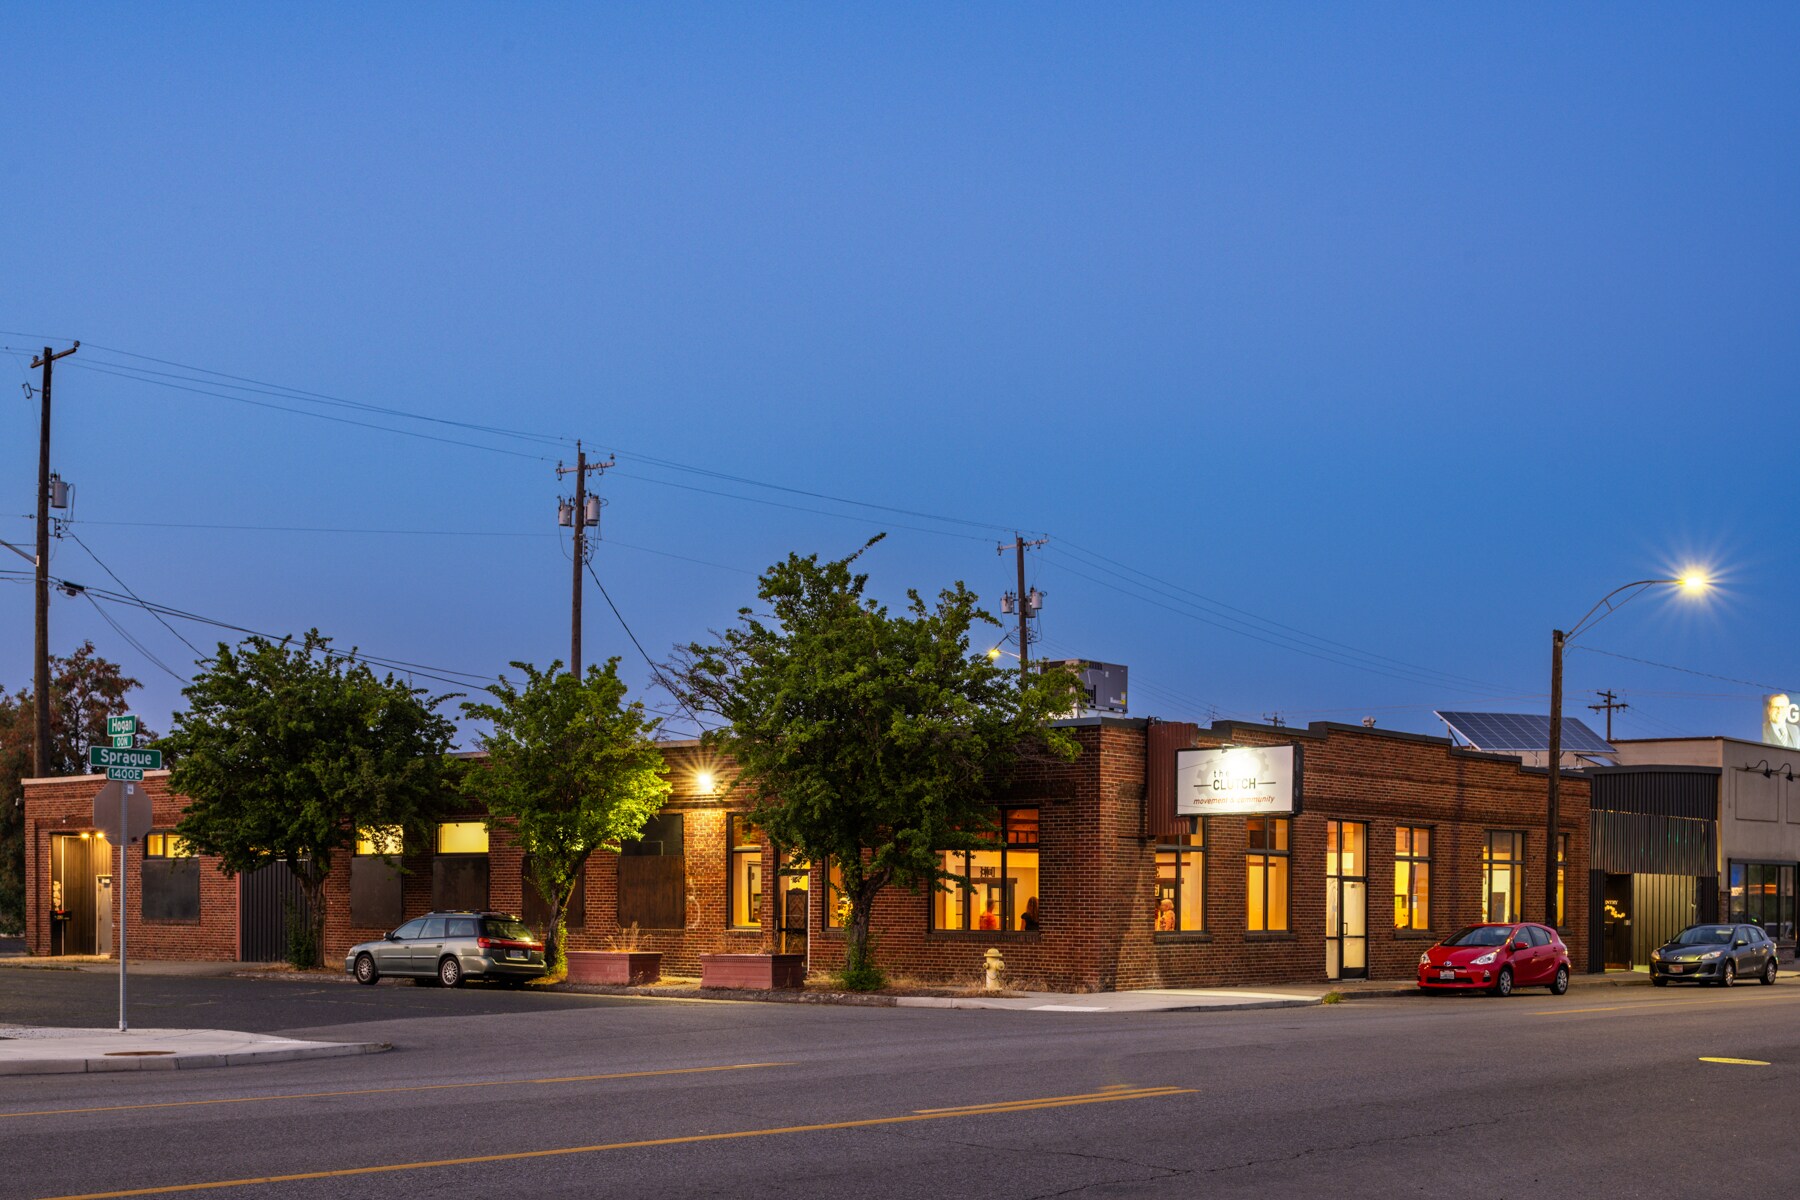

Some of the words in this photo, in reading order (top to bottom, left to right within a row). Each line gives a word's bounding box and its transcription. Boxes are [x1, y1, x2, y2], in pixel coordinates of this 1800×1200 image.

[111, 718, 133, 734] Hogan
[100, 749, 152, 766] Sprague
[111, 769, 140, 779] 1400E
[1213, 778, 1256, 791] CLUTCH
[1193, 797, 1228, 805] movement
